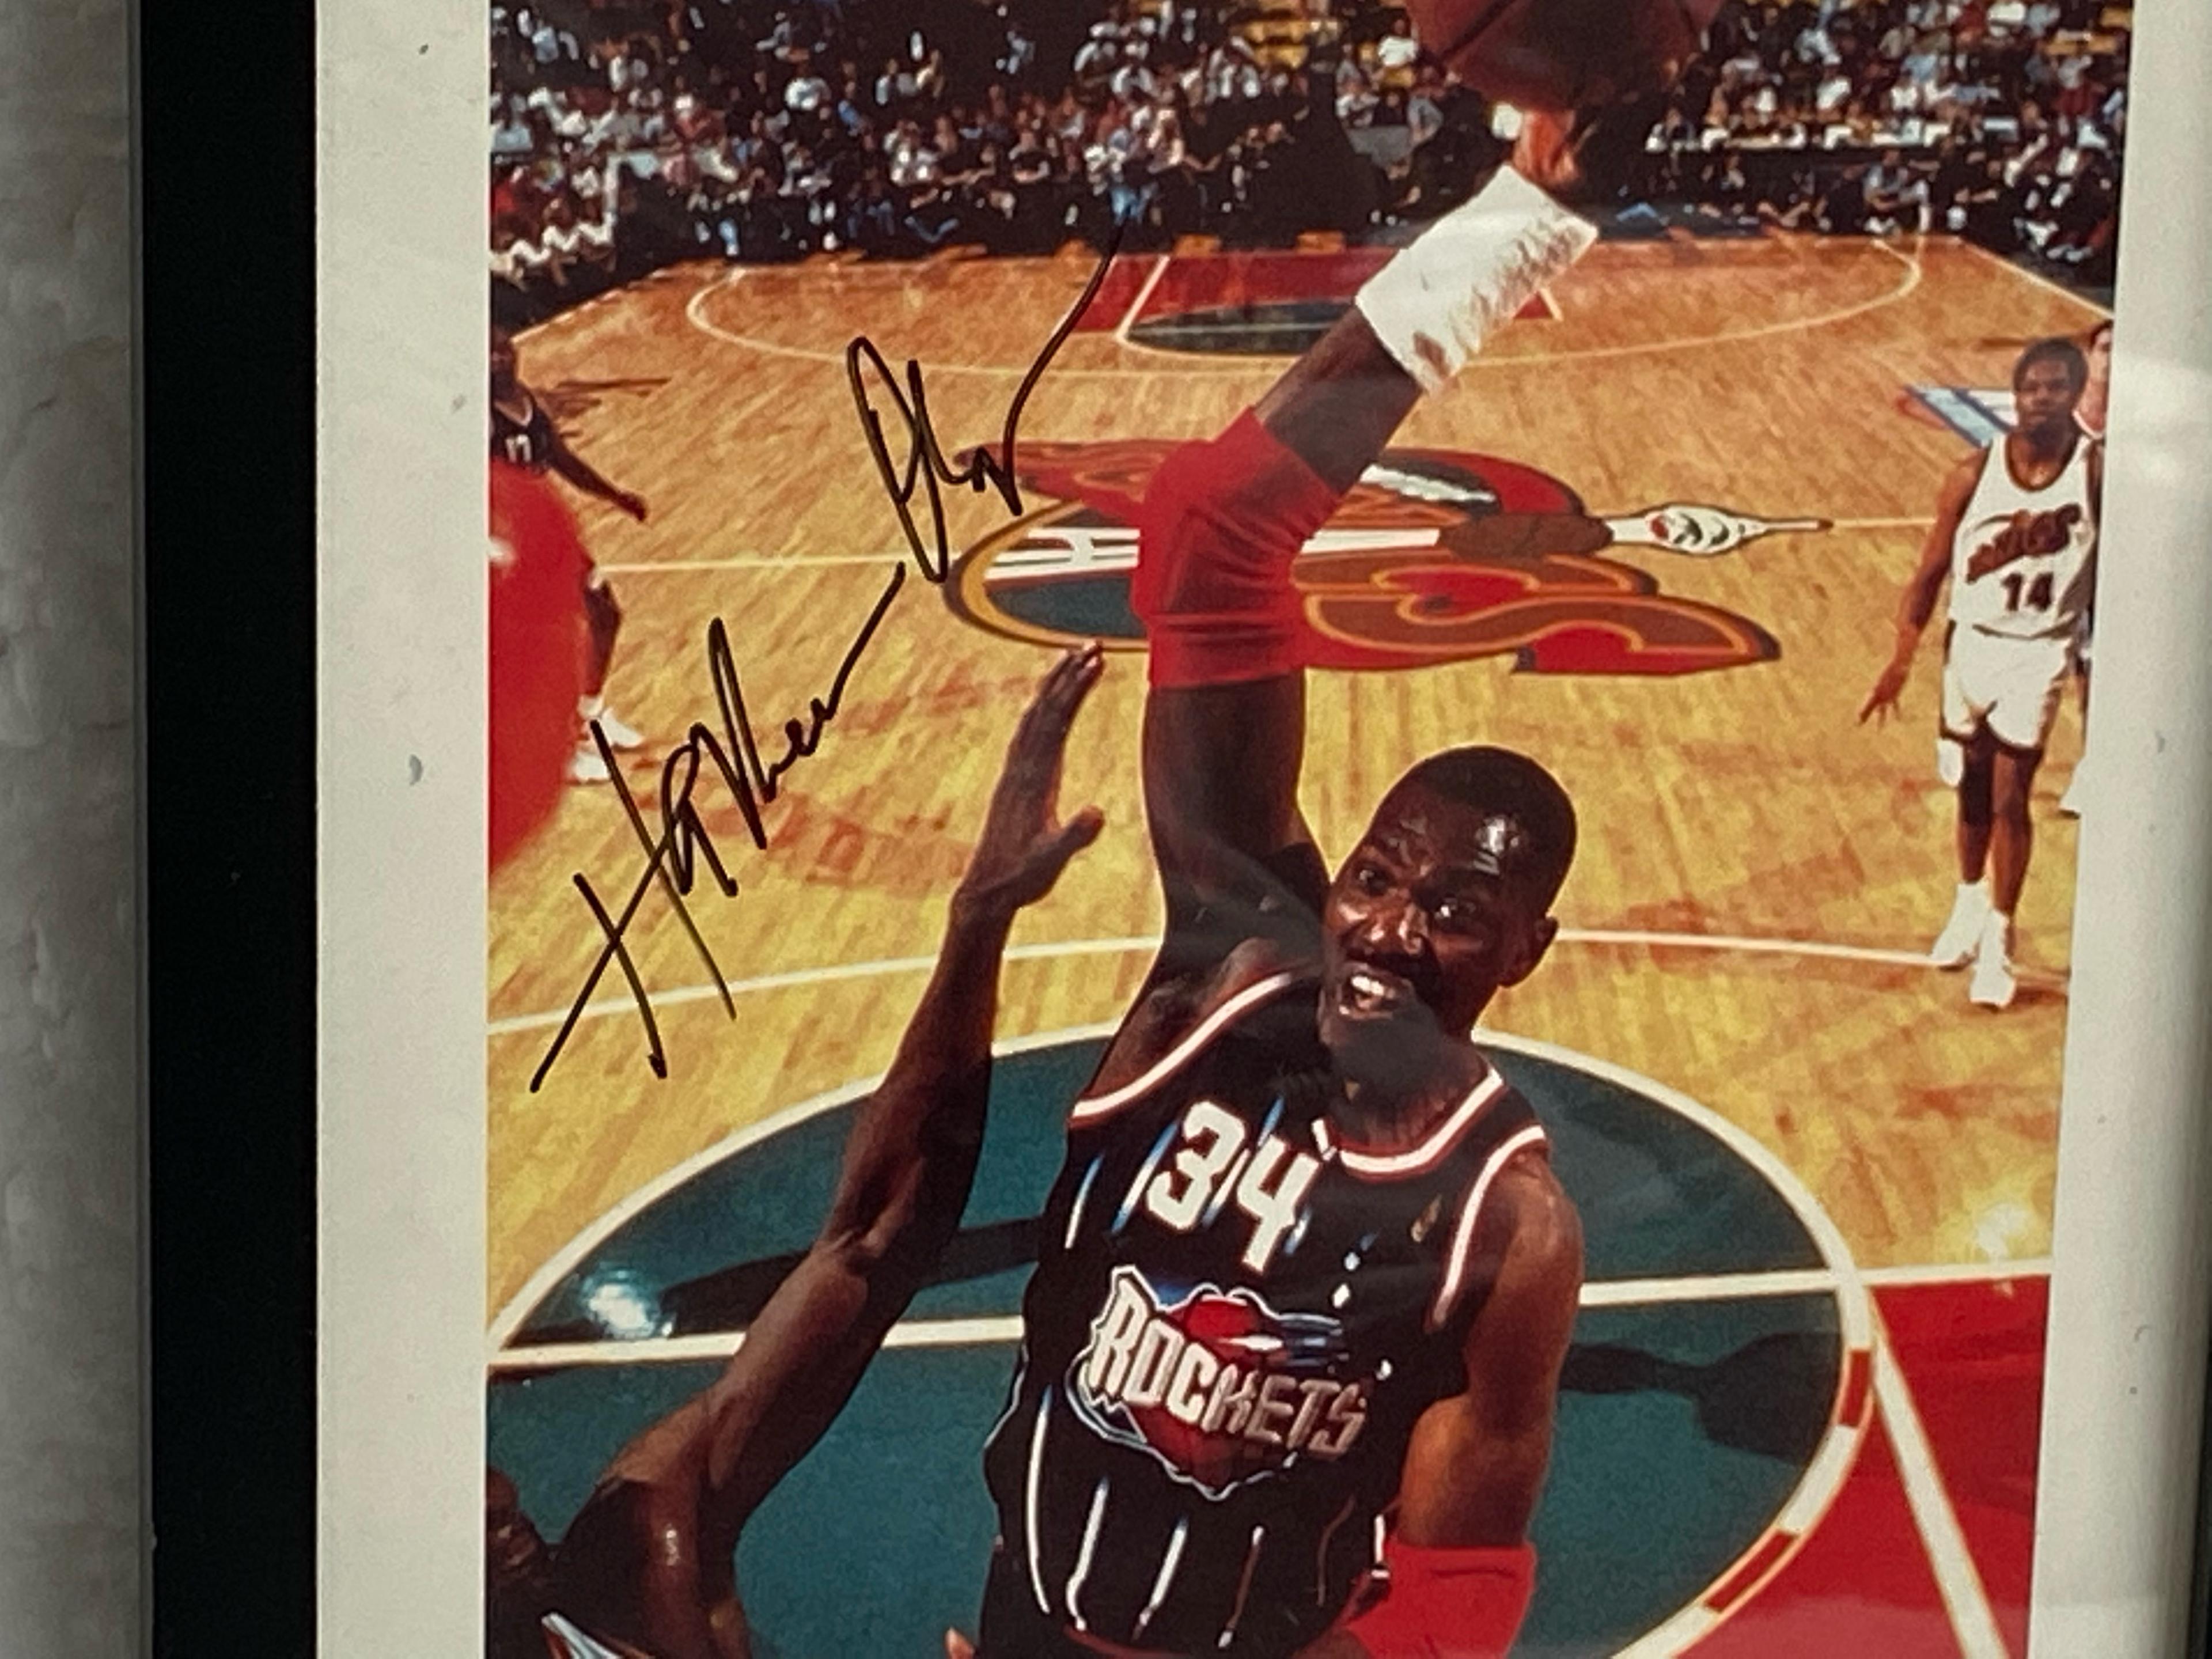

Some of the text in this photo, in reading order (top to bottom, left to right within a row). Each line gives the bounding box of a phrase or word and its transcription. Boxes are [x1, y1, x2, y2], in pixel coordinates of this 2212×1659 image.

[2002, 572, 2054, 612] 14
[1146, 1101, 1320, 1272] 34
[1079, 1277, 1369, 1459] ROCKETS
